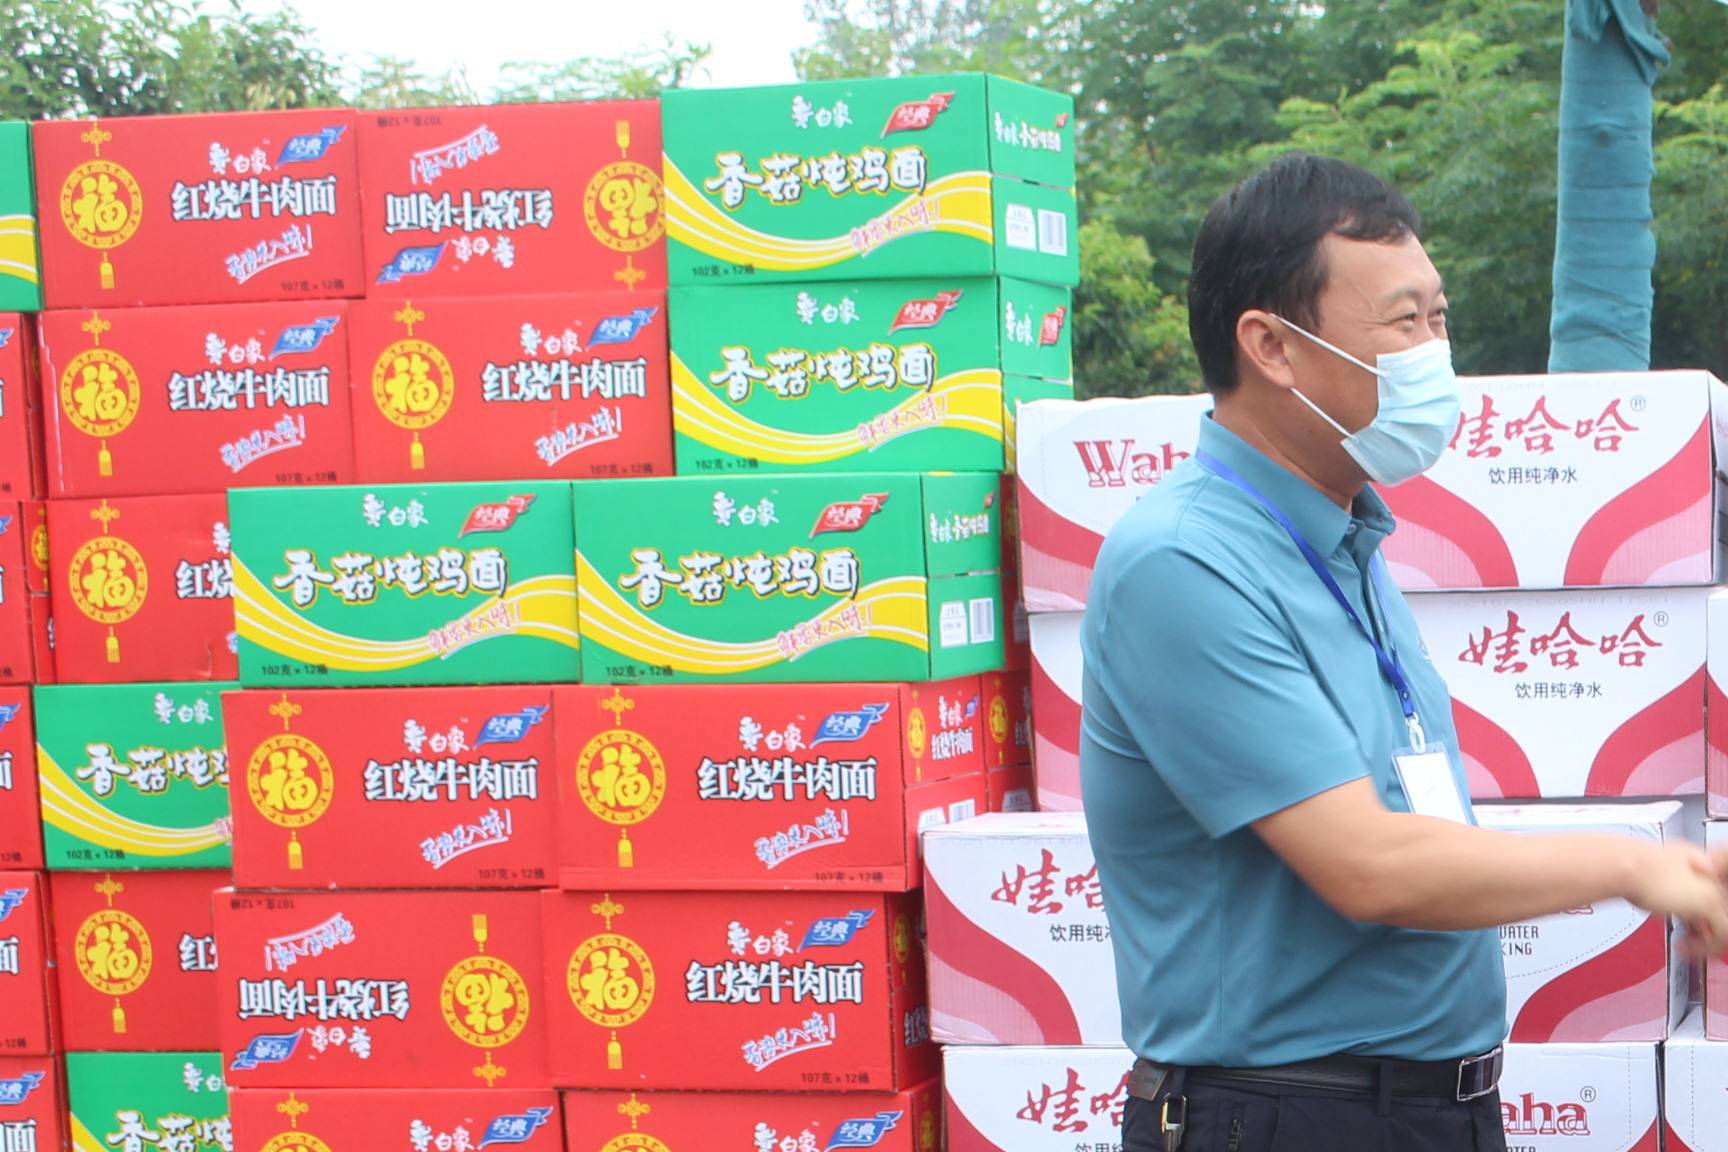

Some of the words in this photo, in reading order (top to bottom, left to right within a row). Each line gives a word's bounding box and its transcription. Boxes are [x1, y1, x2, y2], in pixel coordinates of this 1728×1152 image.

[288, 137, 322, 159] 经典
[171, 177, 336, 220] 红烧牛肉面
[707, 148, 928, 209] 香菇炖鸡面
[73, 177, 126, 232] 福
[386, 191, 552, 232] 红烧牛肉面
[600, 179, 656, 233] 福
[600, 316, 633, 340] 经典
[168, 370, 329, 408] 红烧牛肉面
[384, 358, 439, 412] 福
[482, 360, 646, 400] 红烧牛肉面
[711, 345, 935, 403] 香菇炖鸡面
[1488, 466, 1578, 484] 饮用纯净水
[80, 553, 134, 607] 福
[275, 550, 506, 605] 香菇炖鸡面
[623, 549, 858, 609] 香菇炖鸡面
[1458, 610, 1663, 674] 娃哈哈
[1515, 681, 1602, 700] 饮用纯净水
[363, 759, 538, 800] 红烧牛肉面
[592, 749, 650, 807] 福
[698, 759, 876, 799] 红烧牛肉面
[88, 926, 141, 976] 福
[813, 923, 848, 941] 经典
[239, 979, 409, 1019] 红烧牛肉面
[581, 952, 638, 1009] 福
[686, 963, 863, 1003] 红烧牛肉面
[456, 977, 514, 1031] 福
